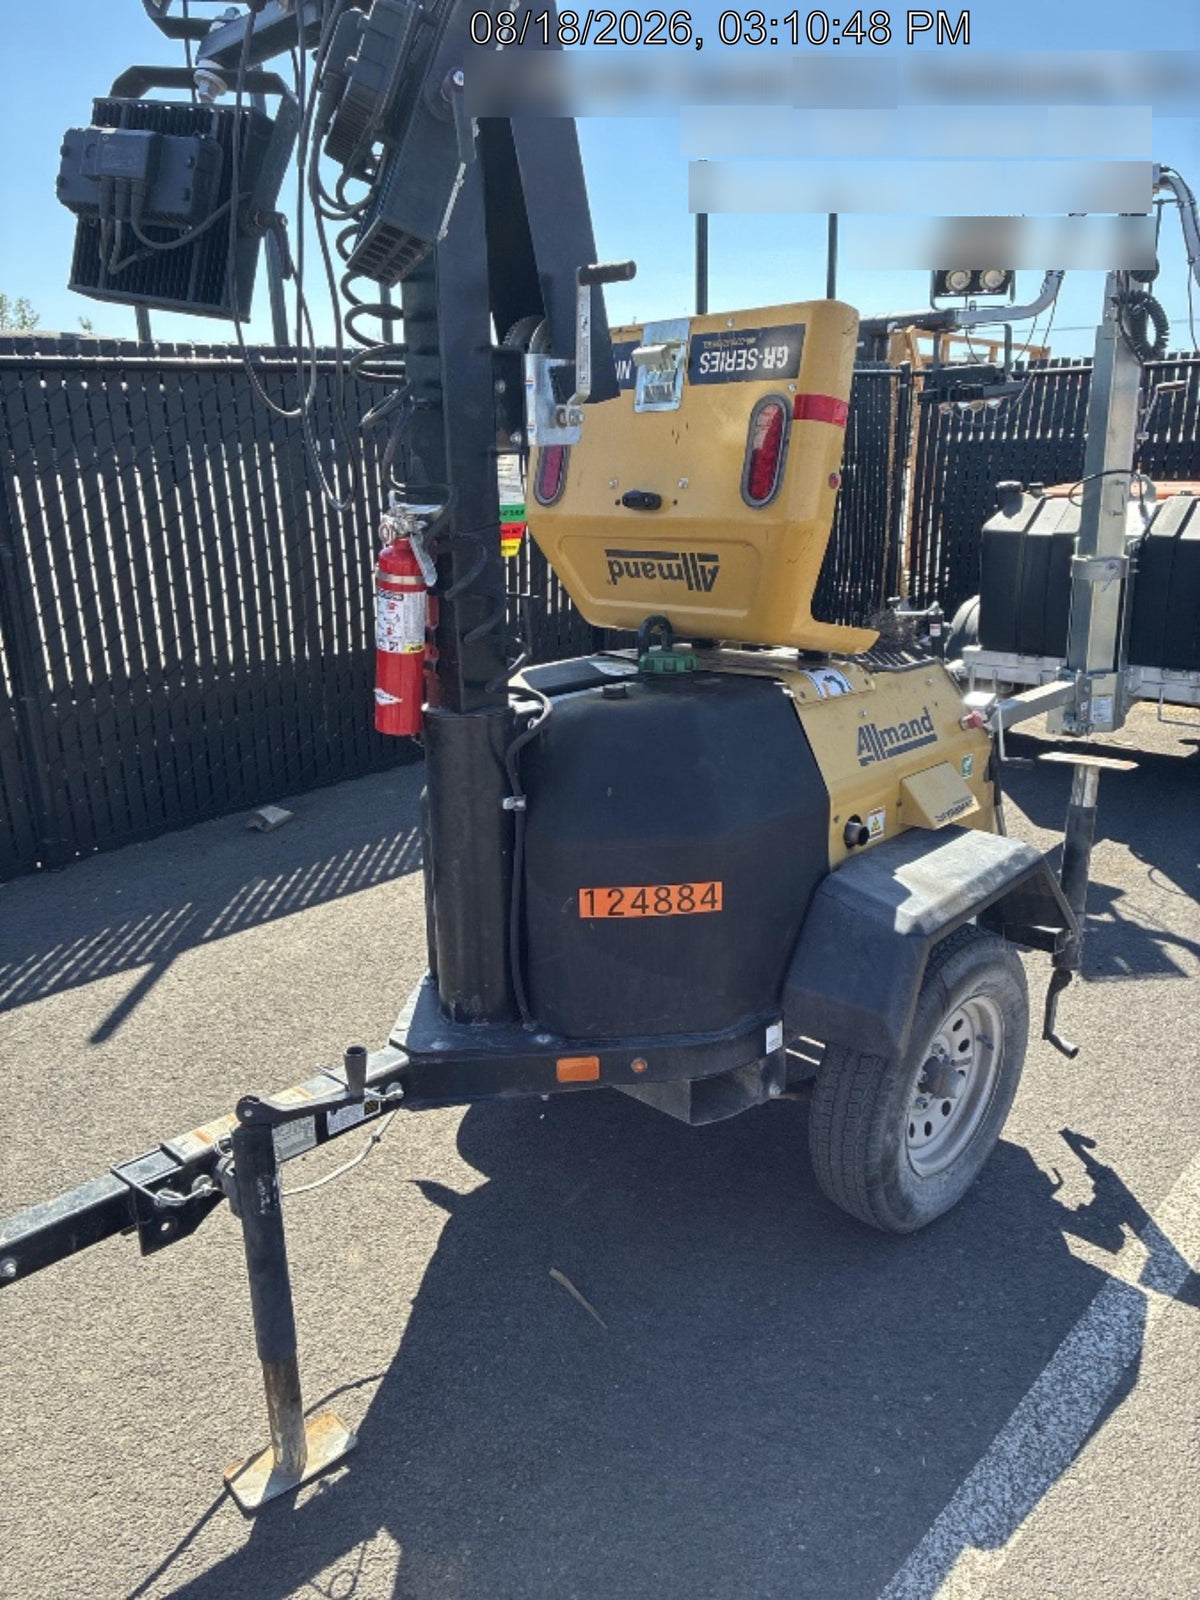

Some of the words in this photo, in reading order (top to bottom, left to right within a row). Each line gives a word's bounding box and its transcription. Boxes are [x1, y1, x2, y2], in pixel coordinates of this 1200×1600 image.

[699, 345, 789, 375] GR-SERIES
[608, 551, 720, 593] Allmand
[857, 706, 935, 763] Allmand
[584, 883, 718, 916] 124884
